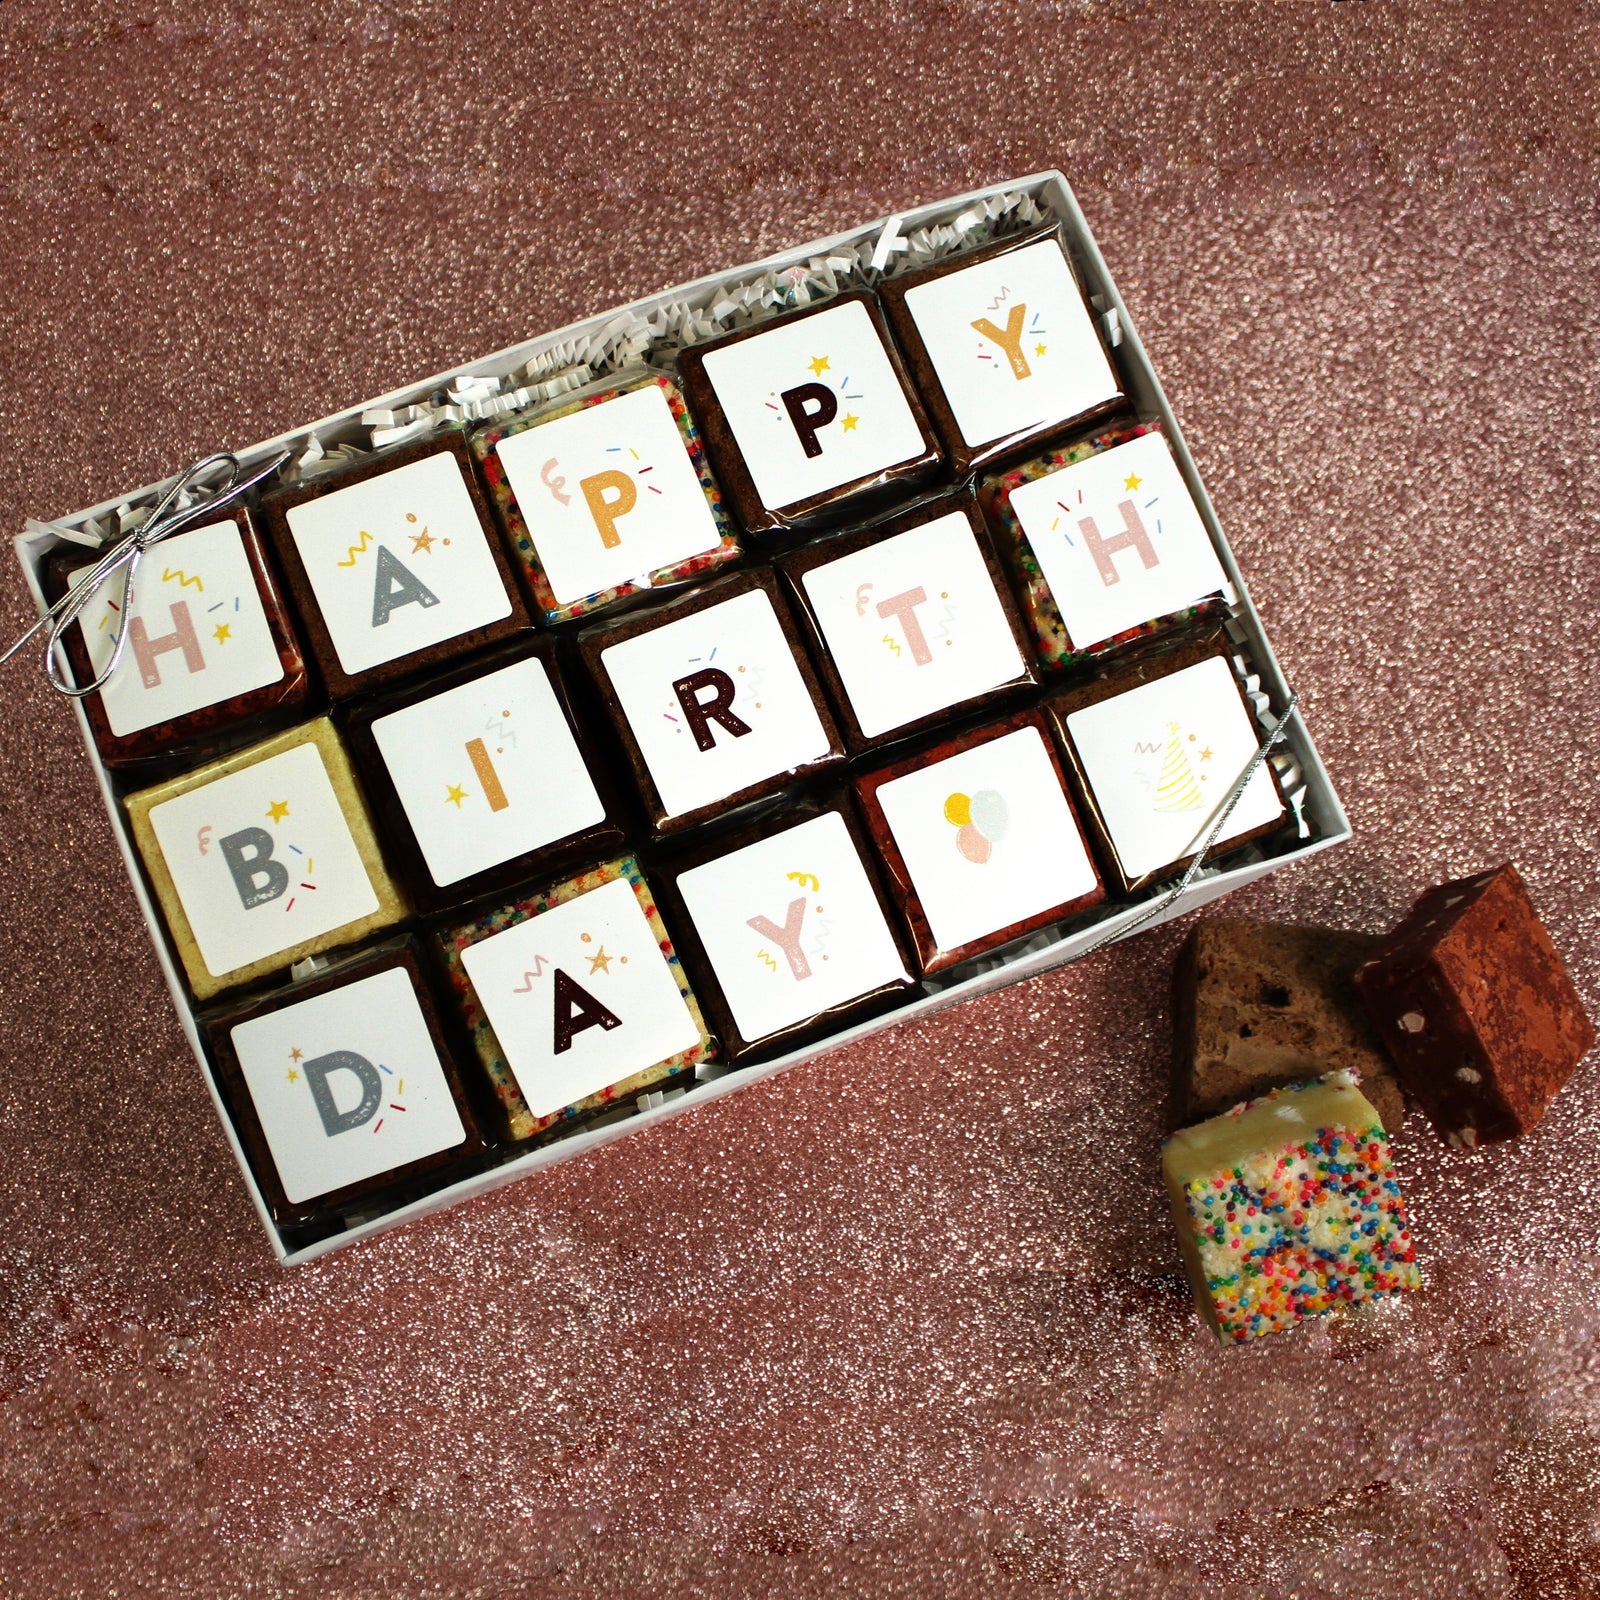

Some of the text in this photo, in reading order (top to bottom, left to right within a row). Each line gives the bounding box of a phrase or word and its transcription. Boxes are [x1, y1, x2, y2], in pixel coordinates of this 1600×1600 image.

[971, 303, 1032, 380] Y
[781, 382, 838, 459] P
[580, 469, 638, 549] P
[1078, 499, 1160, 586] H
[371, 544, 440, 627] A
[876, 585, 932, 666] T
[129, 600, 204, 688] H
[672, 667, 752, 752] R
[219, 825, 289, 910] B
[746, 897, 811, 981] Y
[553, 967, 622, 1055] A
[302, 1050, 382, 1137] D
